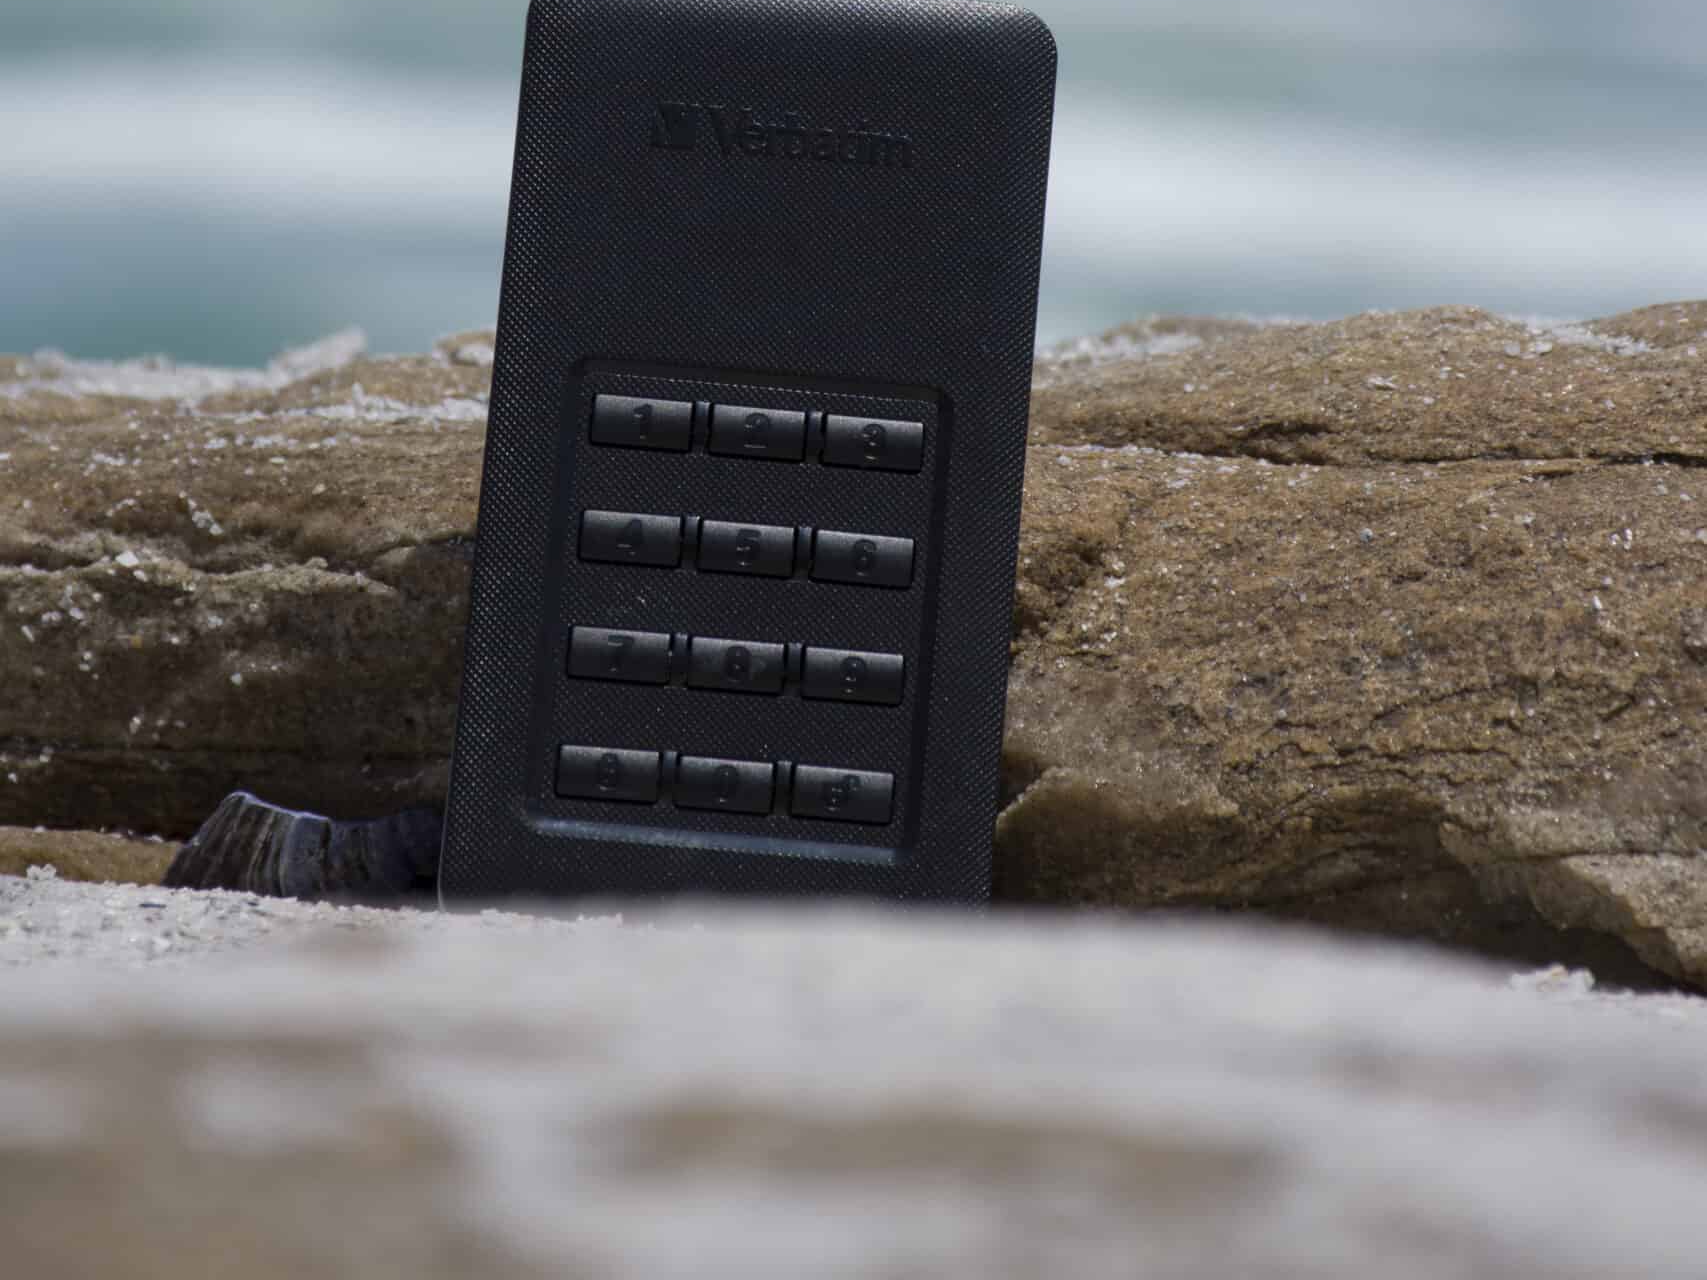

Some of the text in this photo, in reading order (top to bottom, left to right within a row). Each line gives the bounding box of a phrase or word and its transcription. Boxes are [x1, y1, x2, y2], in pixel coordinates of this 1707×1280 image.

[707, 103, 912, 168] Verbatim
[632, 404, 887, 460] 1 2 3
[615, 519, 878, 577] 4 5 6
[607, 634, 866, 694] 7 8 9
[712, 765, 739, 803] 0
